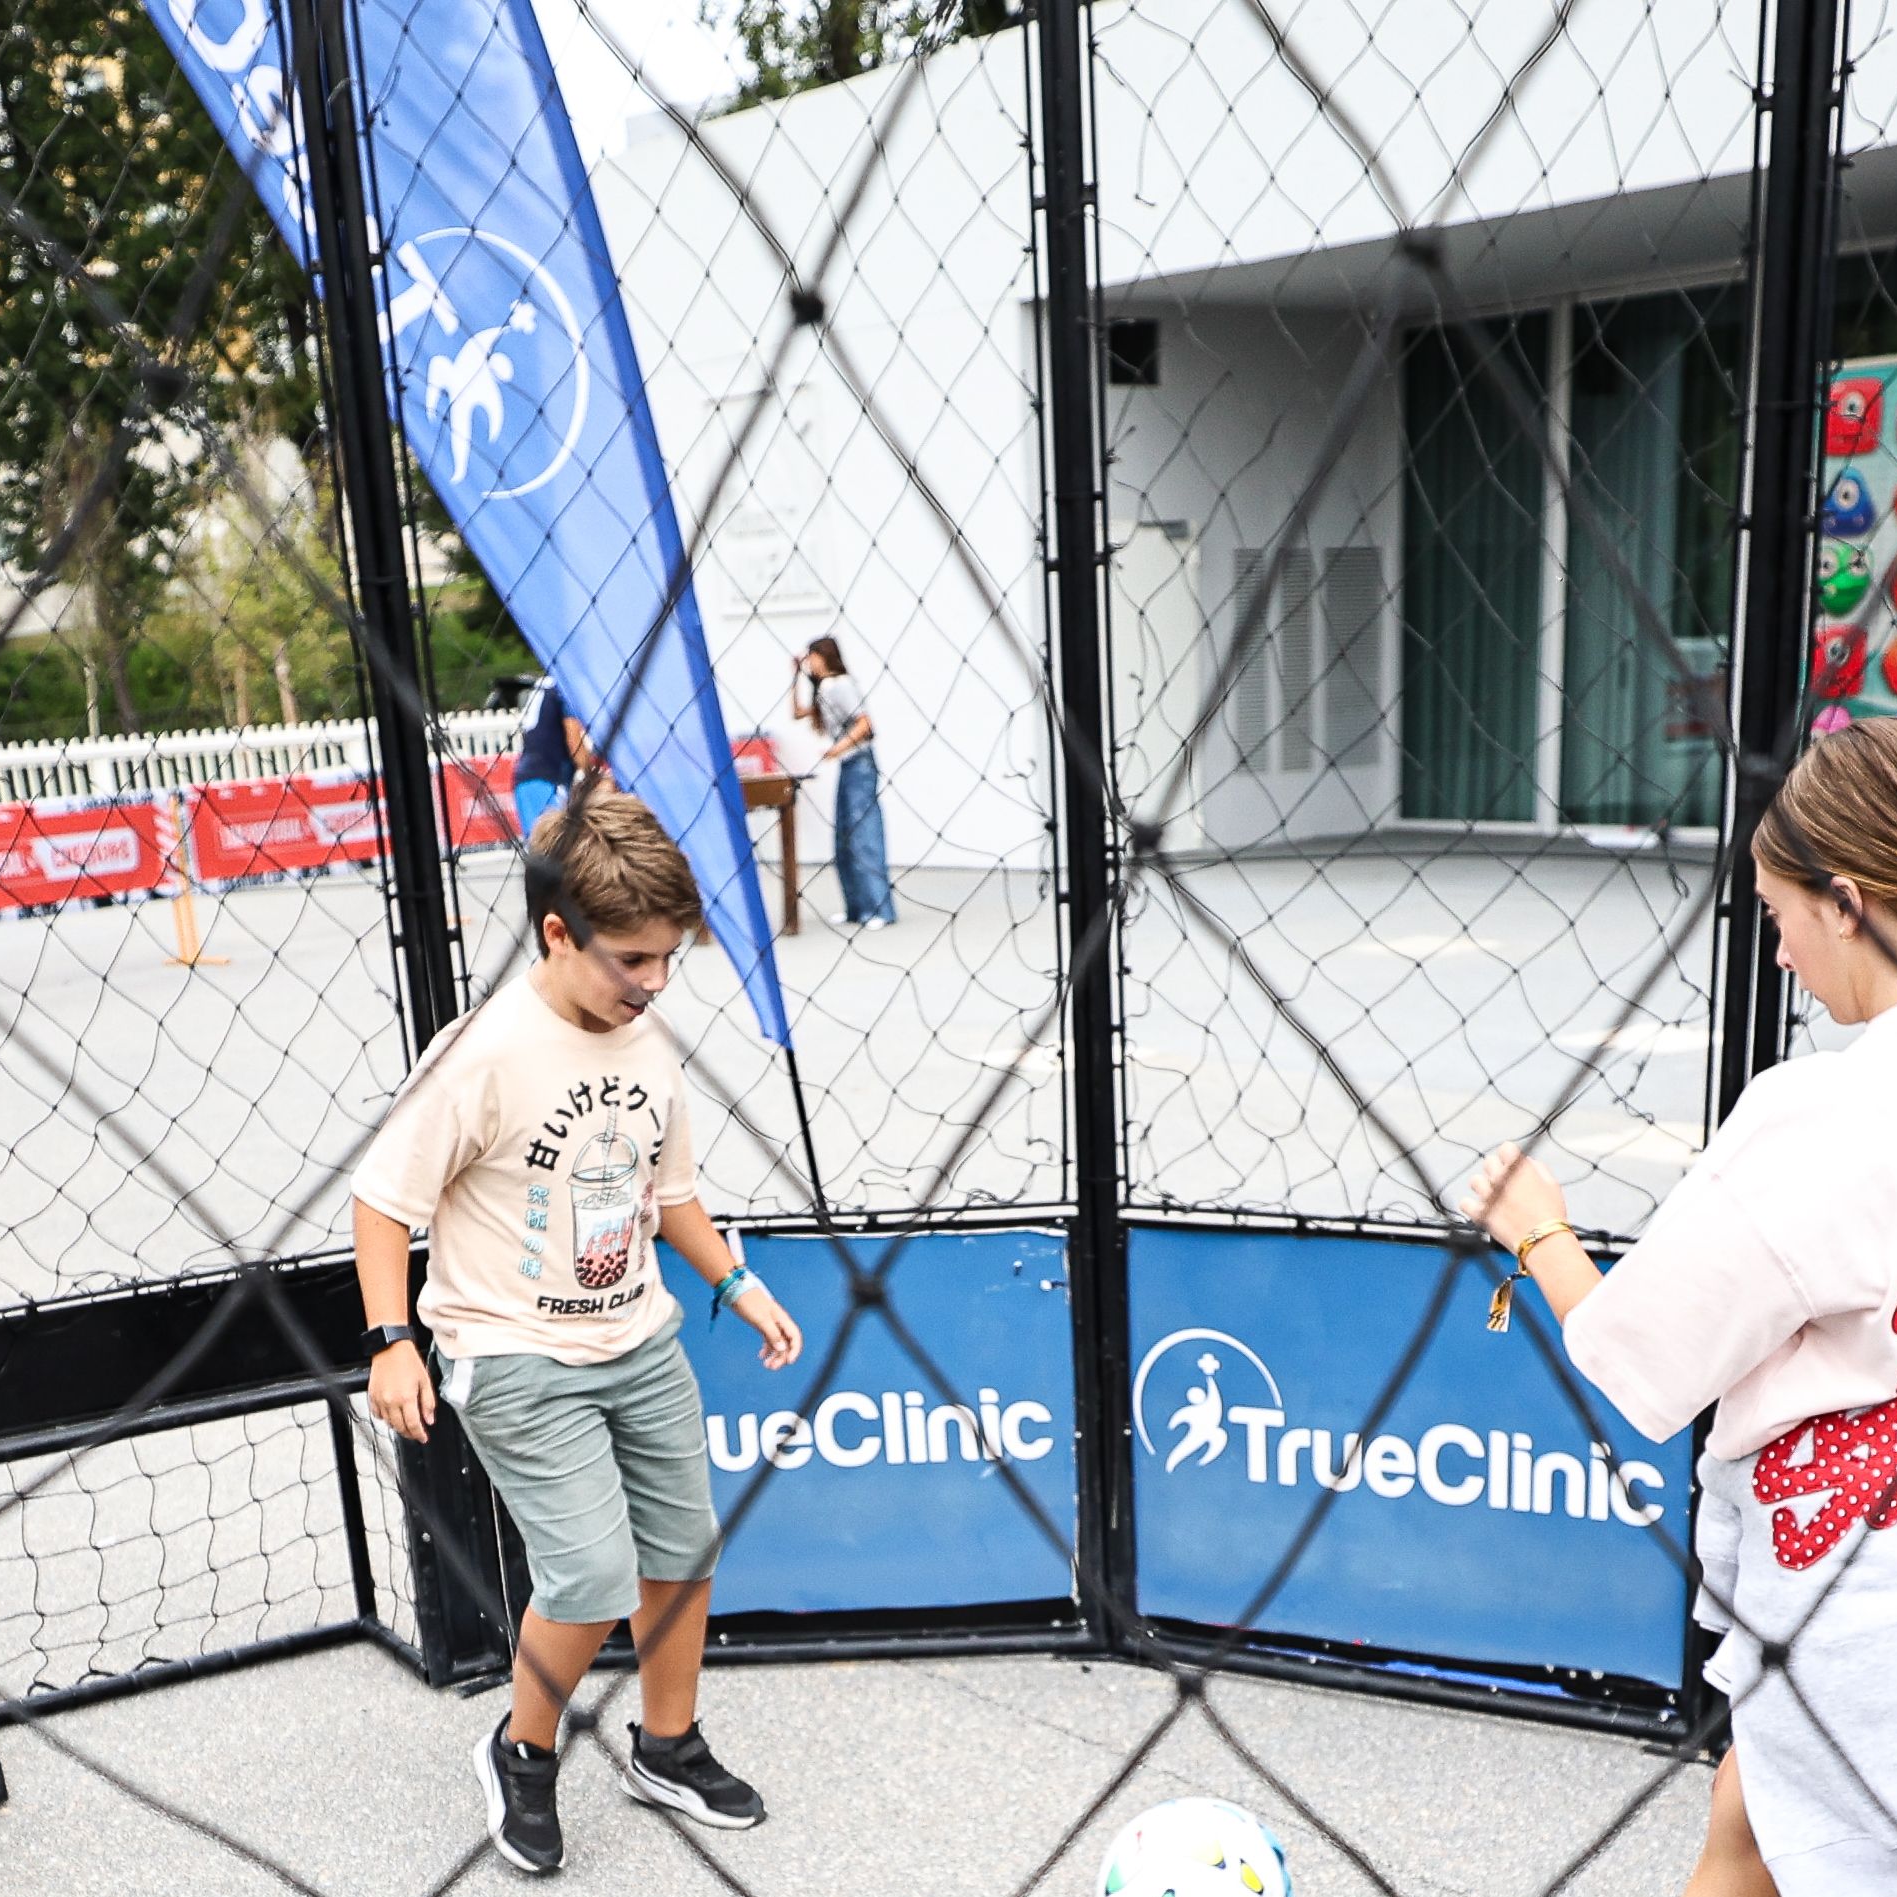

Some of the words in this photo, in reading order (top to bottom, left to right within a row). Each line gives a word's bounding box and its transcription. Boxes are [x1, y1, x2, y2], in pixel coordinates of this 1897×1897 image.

[536, 1295, 604, 1315] FRESH
[607, 1282, 645, 1310] CLUB
[704, 1387, 1055, 1473] ueClinic
[1226, 1405, 1667, 1528] TrueClinic
